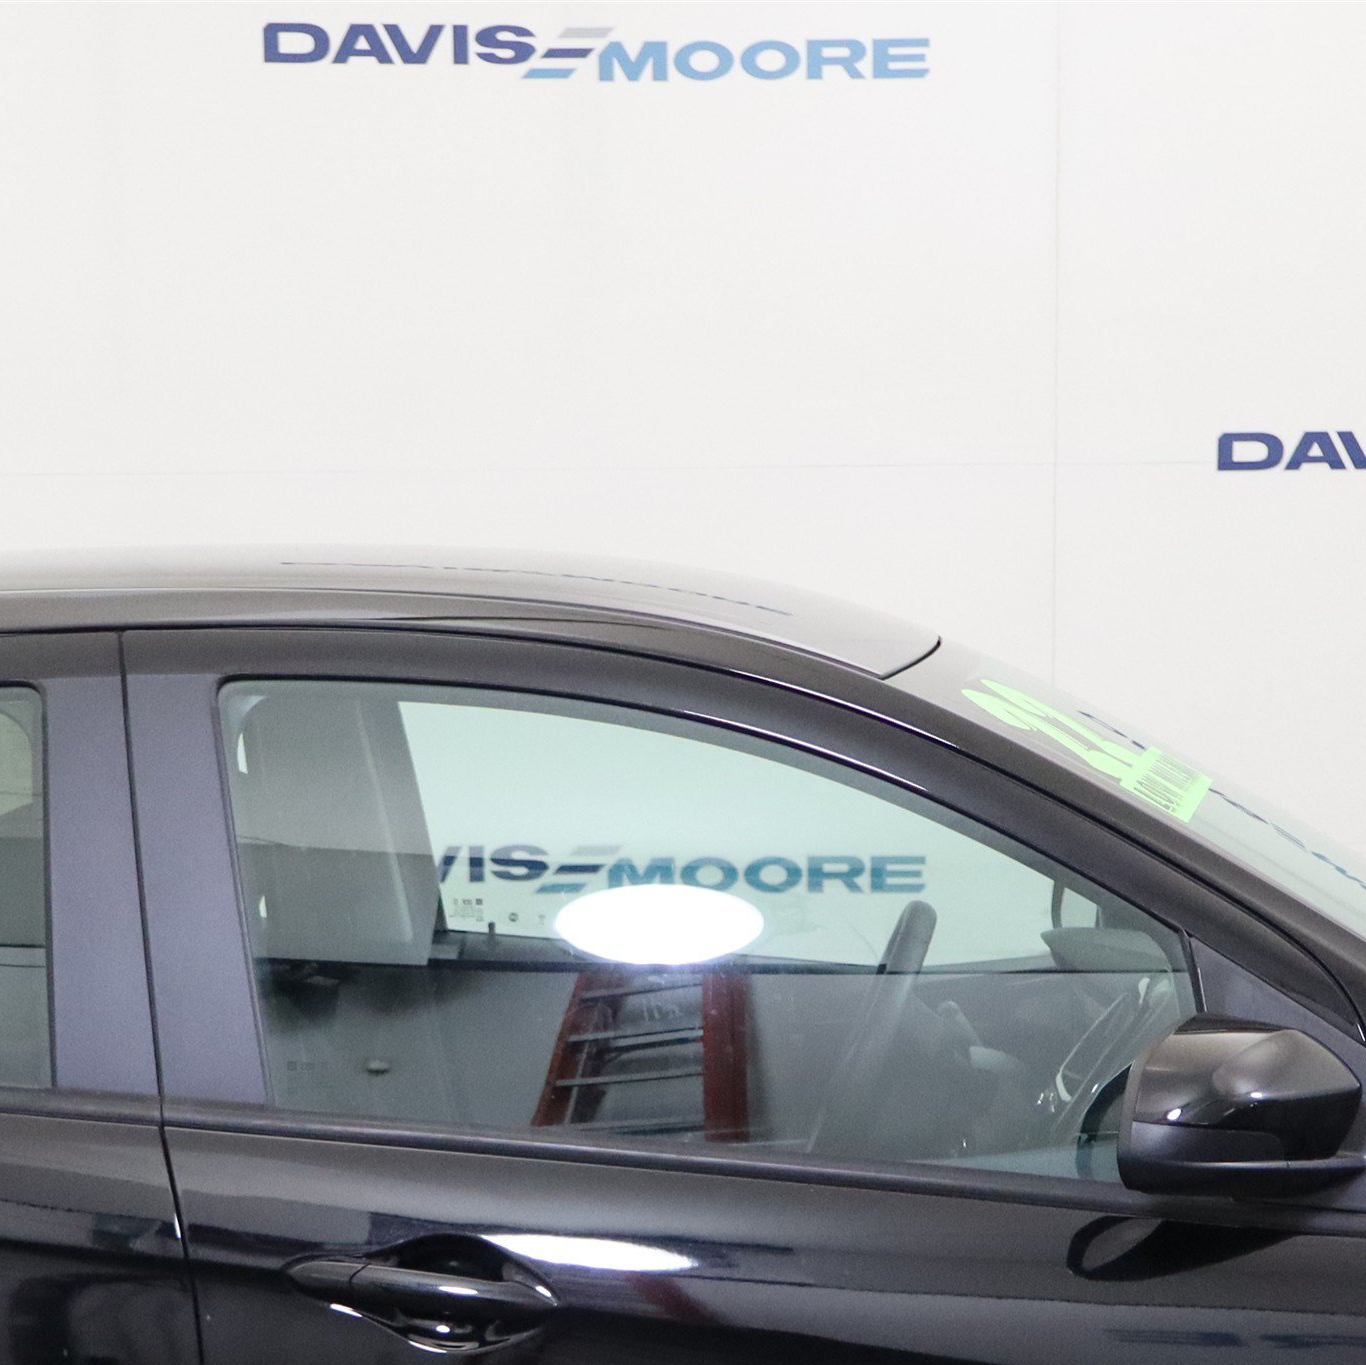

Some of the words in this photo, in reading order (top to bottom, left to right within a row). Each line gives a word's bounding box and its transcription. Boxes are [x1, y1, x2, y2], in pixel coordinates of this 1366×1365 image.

[264, 23, 535, 64] DAVIS
[598, 38, 929, 81] MOORE
[605, 854, 928, 895] MOORE
